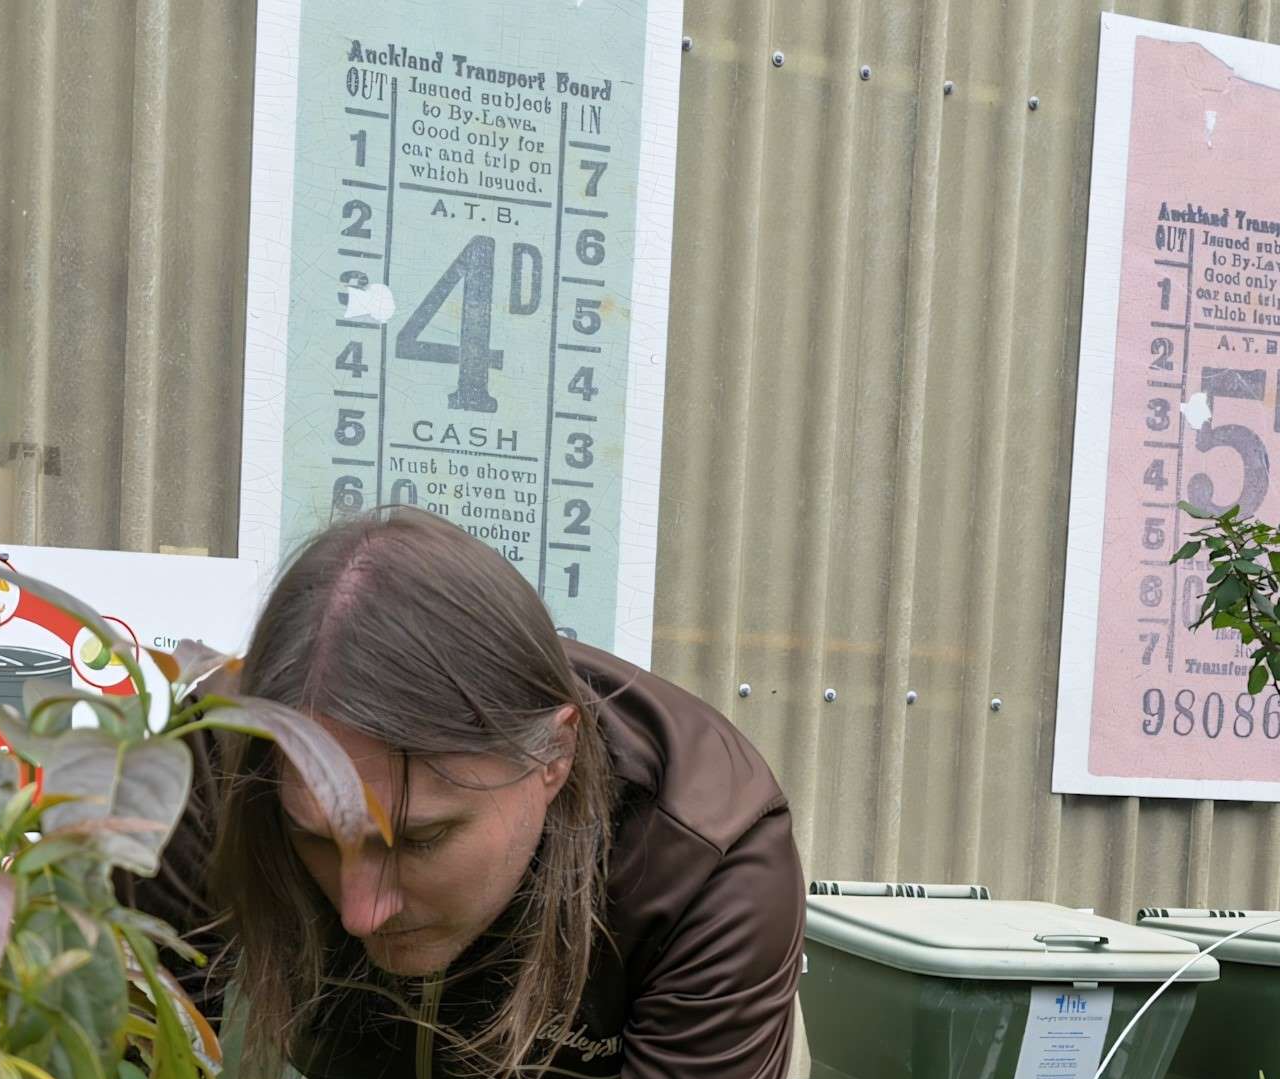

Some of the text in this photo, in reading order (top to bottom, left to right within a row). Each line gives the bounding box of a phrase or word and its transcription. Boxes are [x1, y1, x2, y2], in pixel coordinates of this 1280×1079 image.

[346, 66, 388, 101] OUT
[348, 39, 611, 101] Auckland Transport Board
[409, 76, 551, 114] Issued subject
[422, 103, 442, 119] to
[580, 104, 601, 135] IN
[349, 129, 367, 168] 1
[412, 119, 544, 154] Good only for
[402, 141, 552, 175] car and trip on
[410, 163, 468, 185] which
[580, 160, 608, 197] 7
[341, 200, 373, 239] 2
[1159, 202, 1229, 229] Auckland
[575, 229, 605, 266] 6
[1156, 225, 1186, 253] OUT
[1202, 231, 1250, 251] Issued
[1212, 252, 1226, 266] to
[1157, 277, 1171, 310] 1
[1205, 267, 1241, 286] Good
[1246, 272, 1278, 291] only
[1196, 287, 1220, 301] car
[1224, 290, 1251, 305] and
[573, 298, 601, 336] 5
[1202, 305, 1247, 324] which
[336, 342, 368, 378] 4
[1150, 338, 1174, 370] 2
[568, 367, 598, 402] 4
[334, 409, 365, 446] 5
[1145, 399, 1170, 431] 3
[413, 420, 518, 452] CASH
[566, 433, 594, 469] 3
[390, 457, 537, 484] Must be shown
[1143, 459, 1168, 492] 4
[332, 475, 364, 512] 6
[427, 482, 537, 507] or given up
[427, 502, 536, 524] on demand
[564, 499, 590, 535] 2
[459, 523, 530, 543] nother
[1141, 518, 1165, 550] 5
[564, 563, 579, 598] 1
[1139, 575, 1163, 608] 6
[1138, 632, 1160, 665] 7
